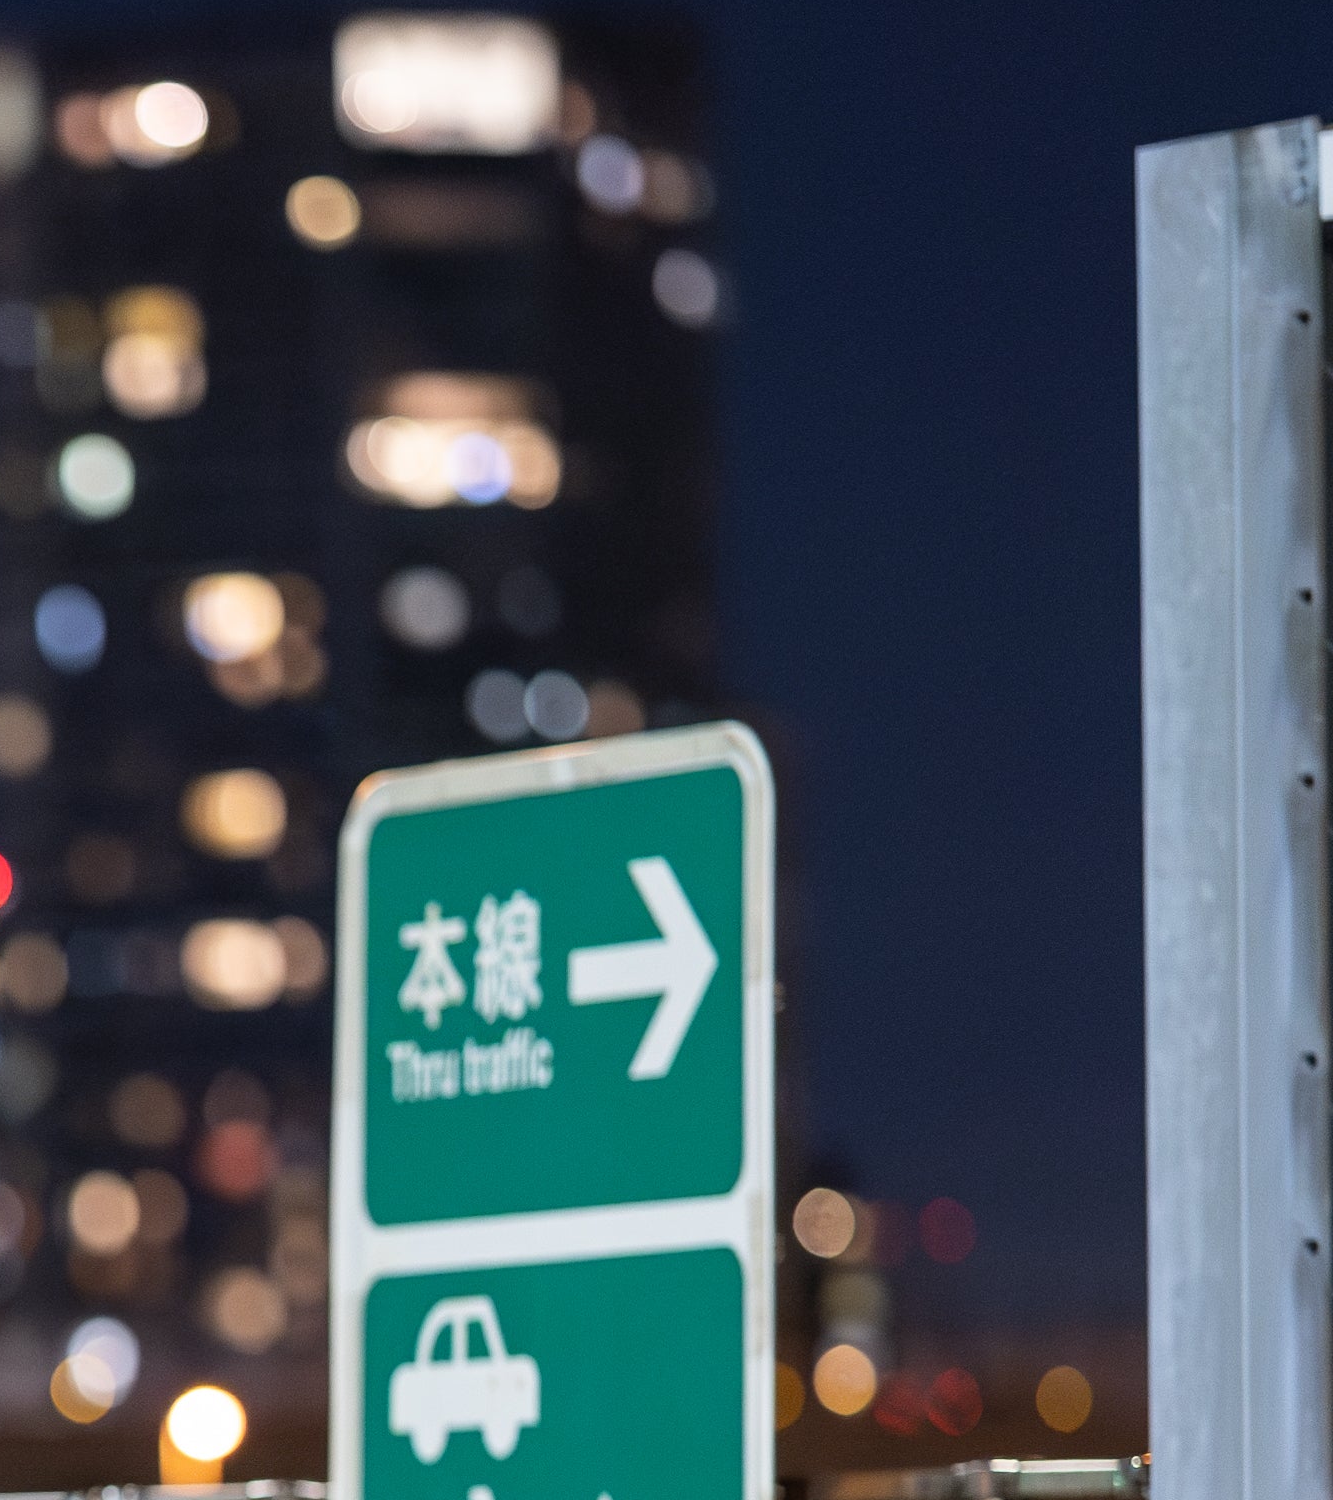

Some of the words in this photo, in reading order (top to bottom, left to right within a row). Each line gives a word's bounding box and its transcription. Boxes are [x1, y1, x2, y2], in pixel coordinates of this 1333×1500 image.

[399, 889, 542, 1030] 本線
[386, 1039, 461, 1103] Thru
[463, 1026, 554, 1096] traffic
